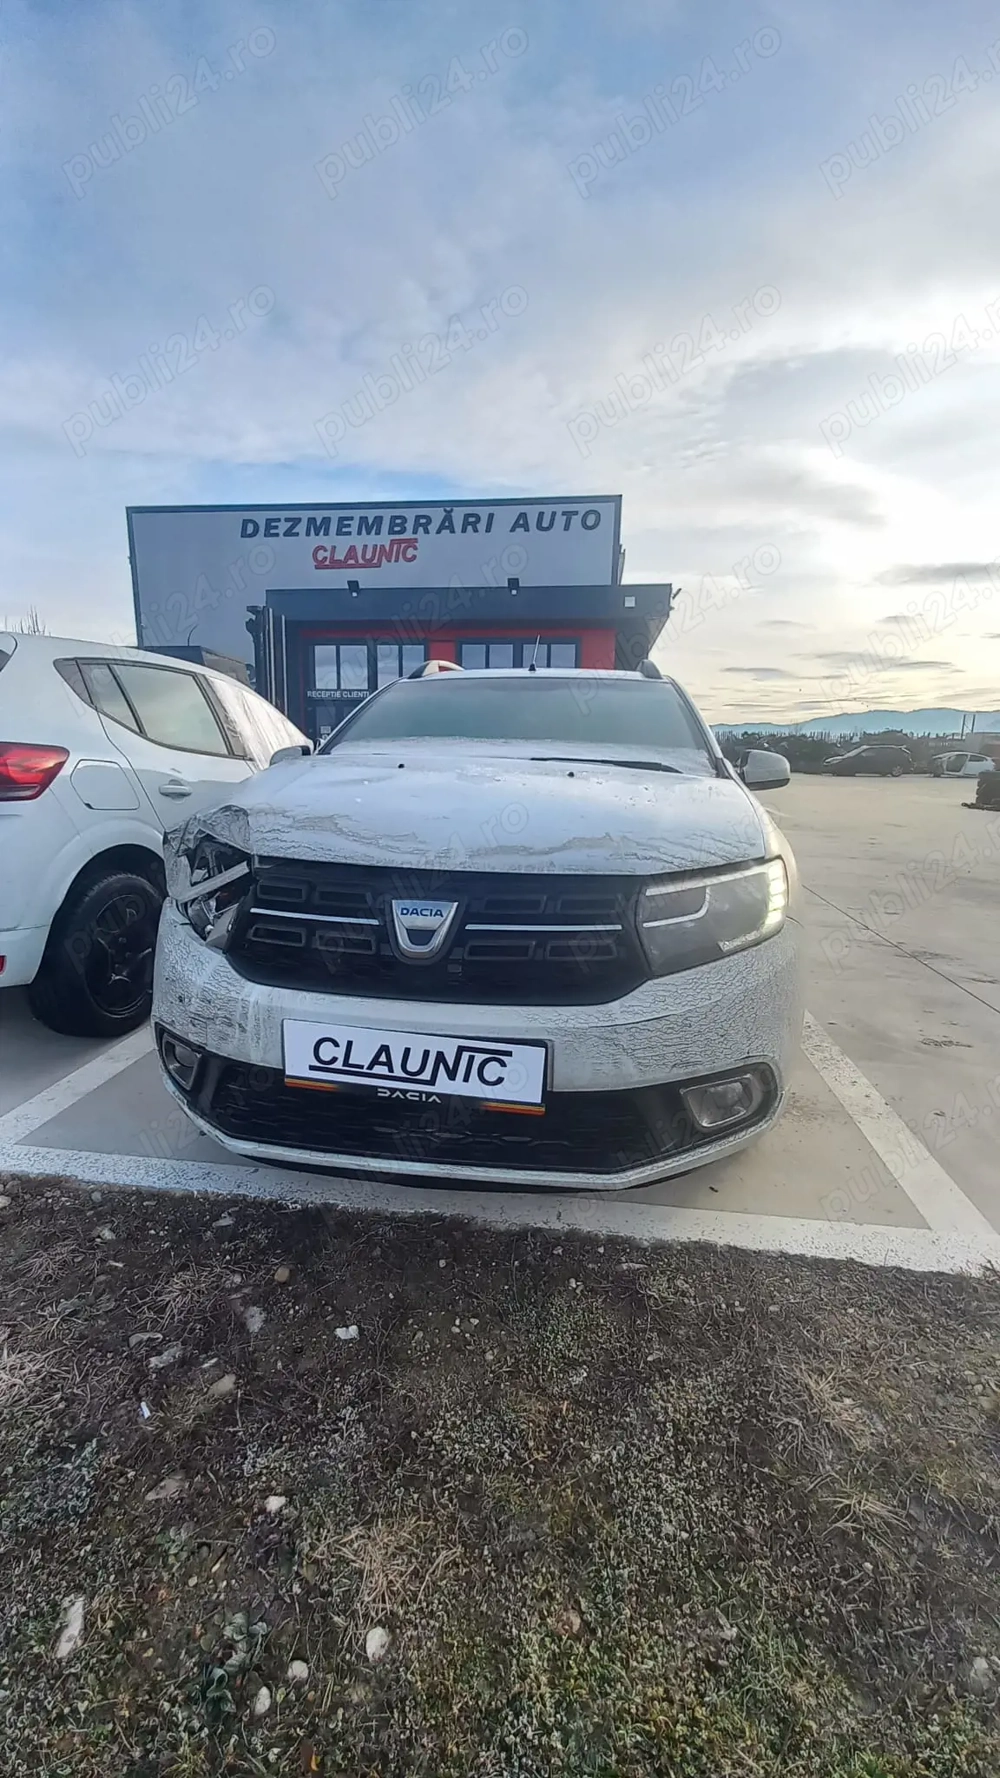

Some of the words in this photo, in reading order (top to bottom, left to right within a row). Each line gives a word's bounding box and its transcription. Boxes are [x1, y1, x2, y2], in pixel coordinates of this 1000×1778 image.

[240, 508, 494, 539] DEZMEMBRĂRI
[509, 509, 602, 533] AUTO
[312, 537, 418, 570] CLAUNIC
[400, 907, 444, 918] DACIA
[309, 1036, 513, 1087] CLAUNIC
